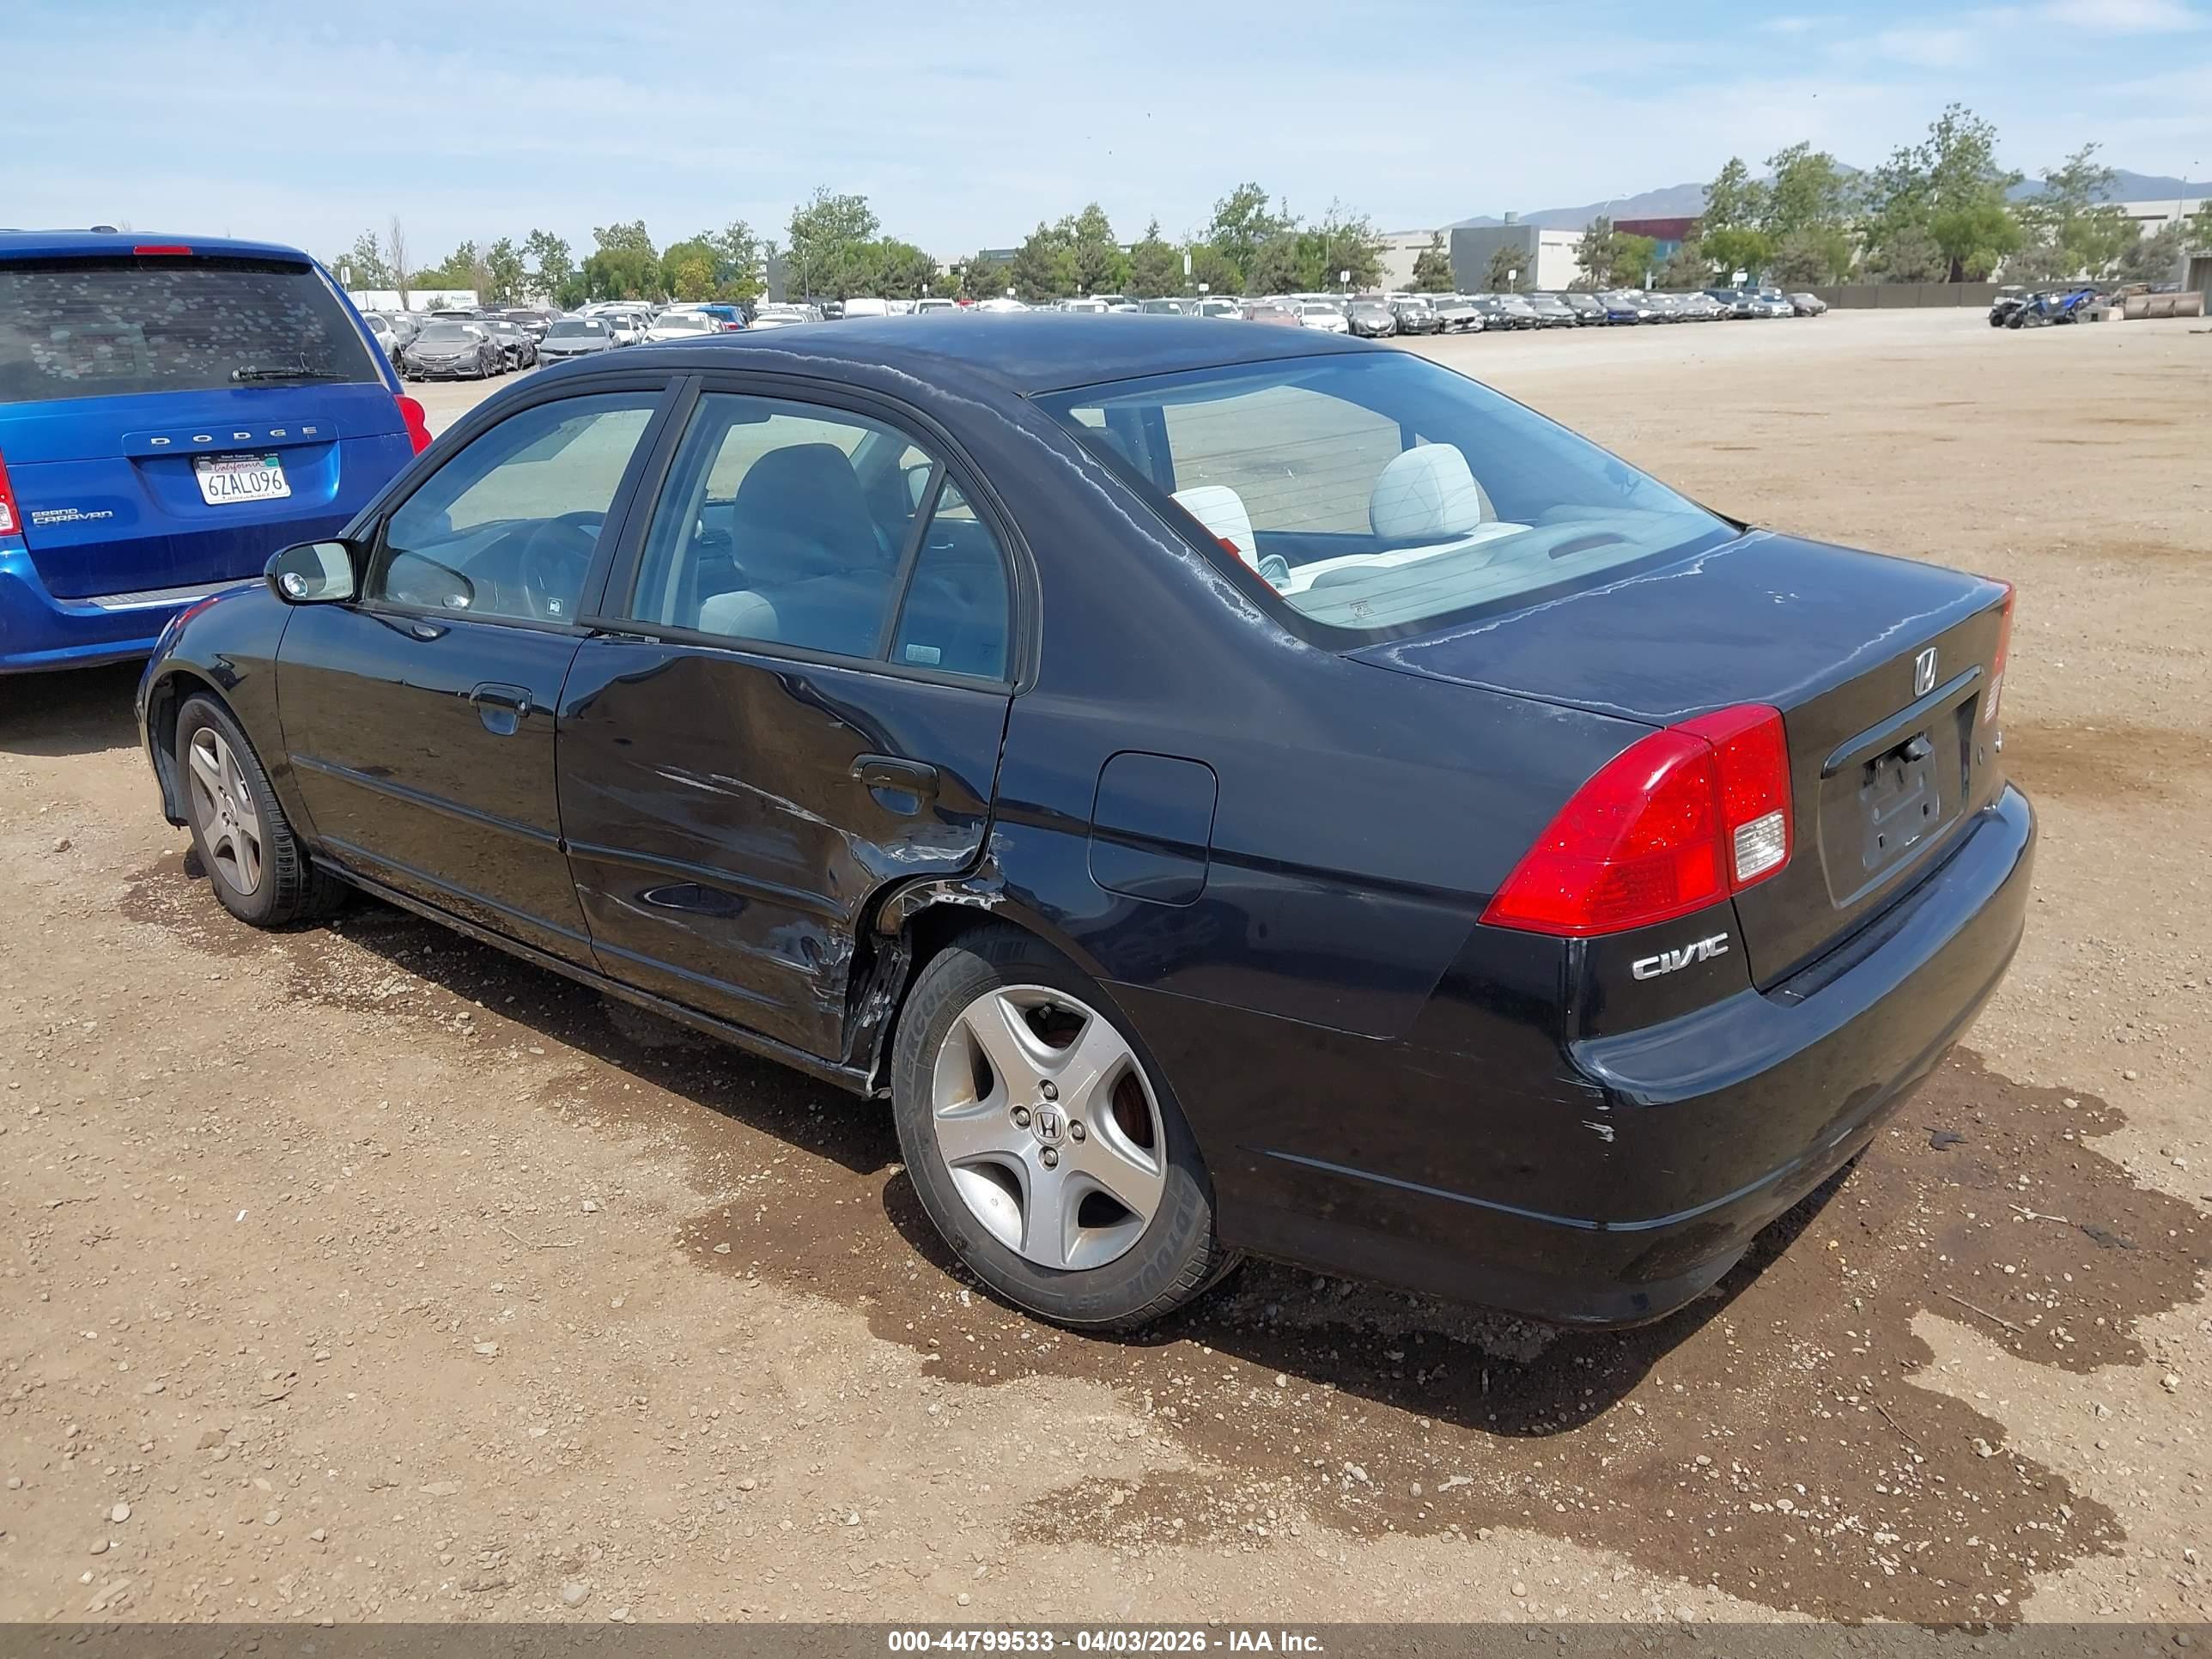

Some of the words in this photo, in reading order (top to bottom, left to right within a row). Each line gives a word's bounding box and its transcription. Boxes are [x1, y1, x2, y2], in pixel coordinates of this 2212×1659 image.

[150, 426, 318, 446] DODGE
[214, 461, 263, 473] California
[208, 470, 283, 496] 6ZAL096
[31, 507, 78, 517] GRAND
[33, 511, 113, 525] CARAVAN
[1632, 932, 1729, 981] CIVIC
